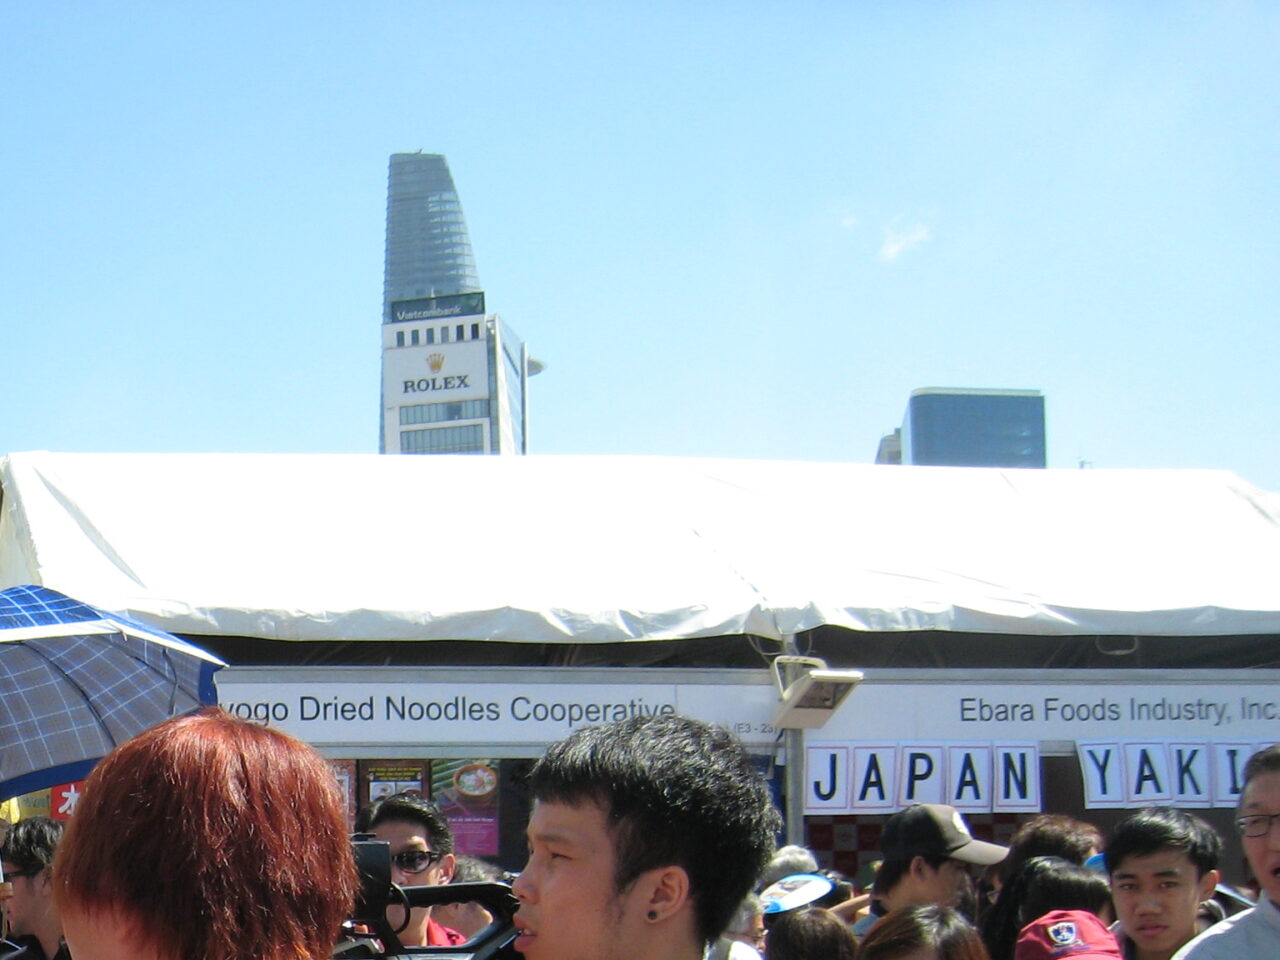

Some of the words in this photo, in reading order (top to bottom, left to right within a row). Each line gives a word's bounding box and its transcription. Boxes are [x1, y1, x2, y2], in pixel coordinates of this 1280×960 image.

[397, 306, 462, 320] Vietcombank
[403, 375, 470, 394] ROLEX
[300, 696, 374, 721] Dried
[386, 696, 500, 721] Noodles
[510, 696, 676, 727] Cooperative
[959, 698, 1035, 722] Ebara
[1044, 698, 1120, 722] Foods
[1130, 697, 1232, 726] Industry,
[1241, 697, 1280, 721] Inc.
[813, 752, 1028, 801] JAPAN
[1087, 749, 1242, 795] YAKI
